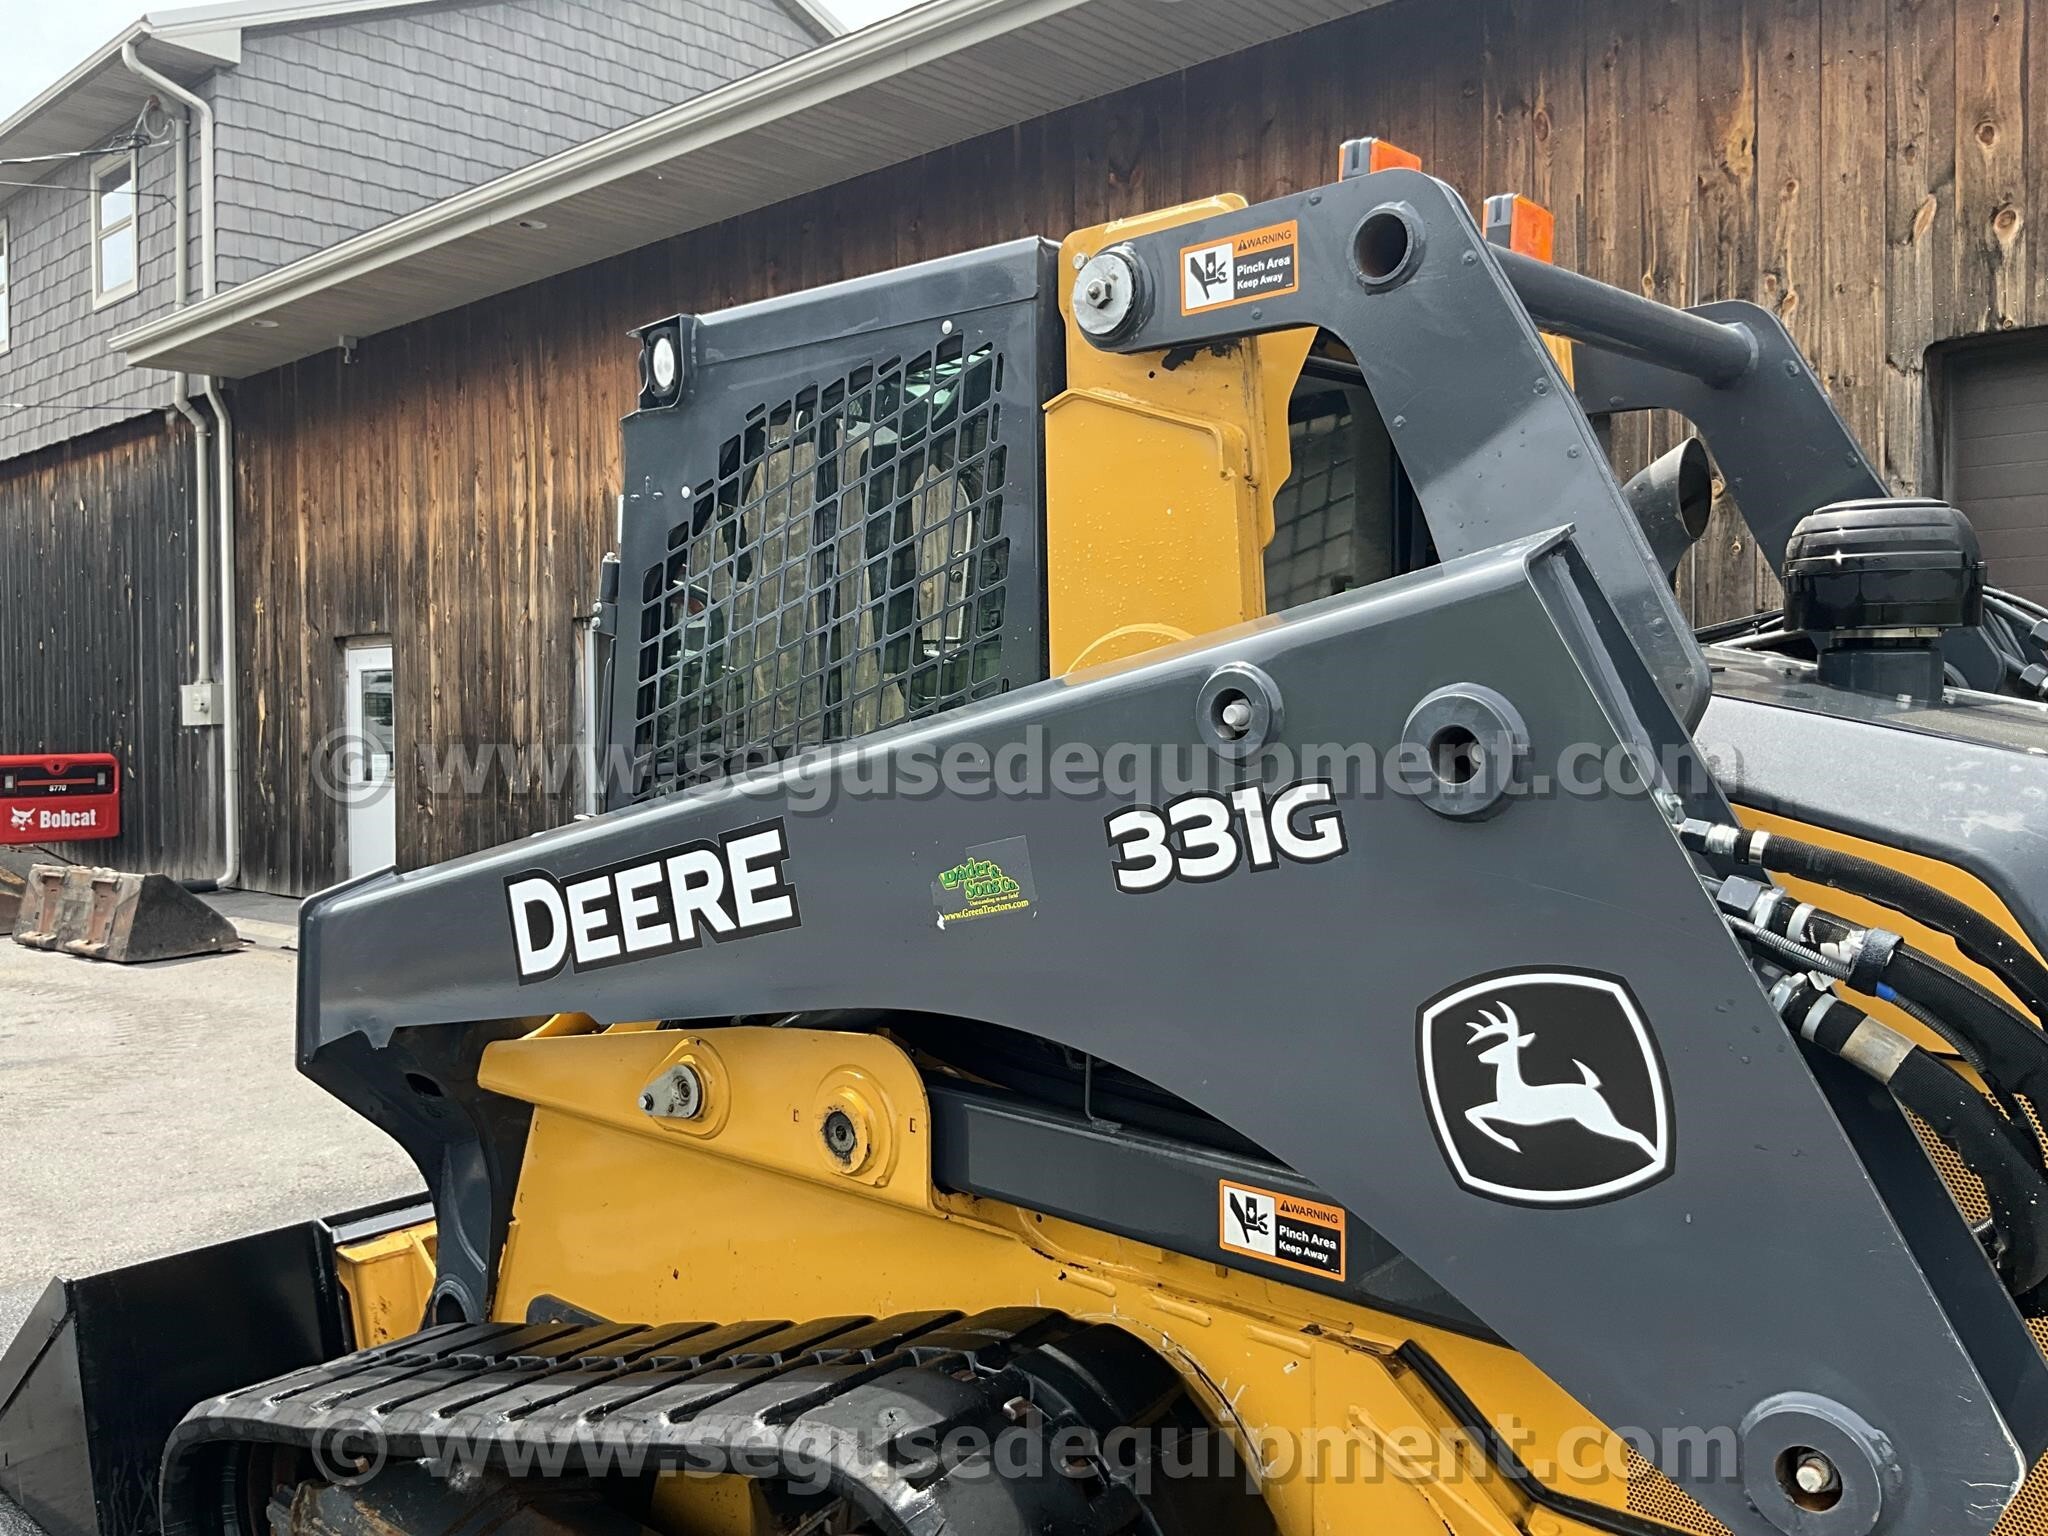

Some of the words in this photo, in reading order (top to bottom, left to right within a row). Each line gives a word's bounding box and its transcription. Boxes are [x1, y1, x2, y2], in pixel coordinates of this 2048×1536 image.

[1247, 230, 1292, 248] WARNING
[1236, 260, 1265, 277] Pinch
[1266, 255, 1291, 269] Area
[1236, 278, 1259, 290] Keep
[1260, 272, 1283, 286] Away
[40, 809, 96, 829] Bobcat
[1106, 781, 1346, 891] 331G
[965, 879, 1001, 899] Sons
[508, 829, 793, 976] DEERE
[944, 900, 1029, 920] www.GreenTractors.com
[1290, 1202, 1338, 1224] WARNING
[1279, 1225, 1309, 1242] Pinch
[1311, 1233, 1337, 1250] Area
[1278, 1240, 1302, 1256] Keep
[1303, 1247, 1328, 1263] Away
